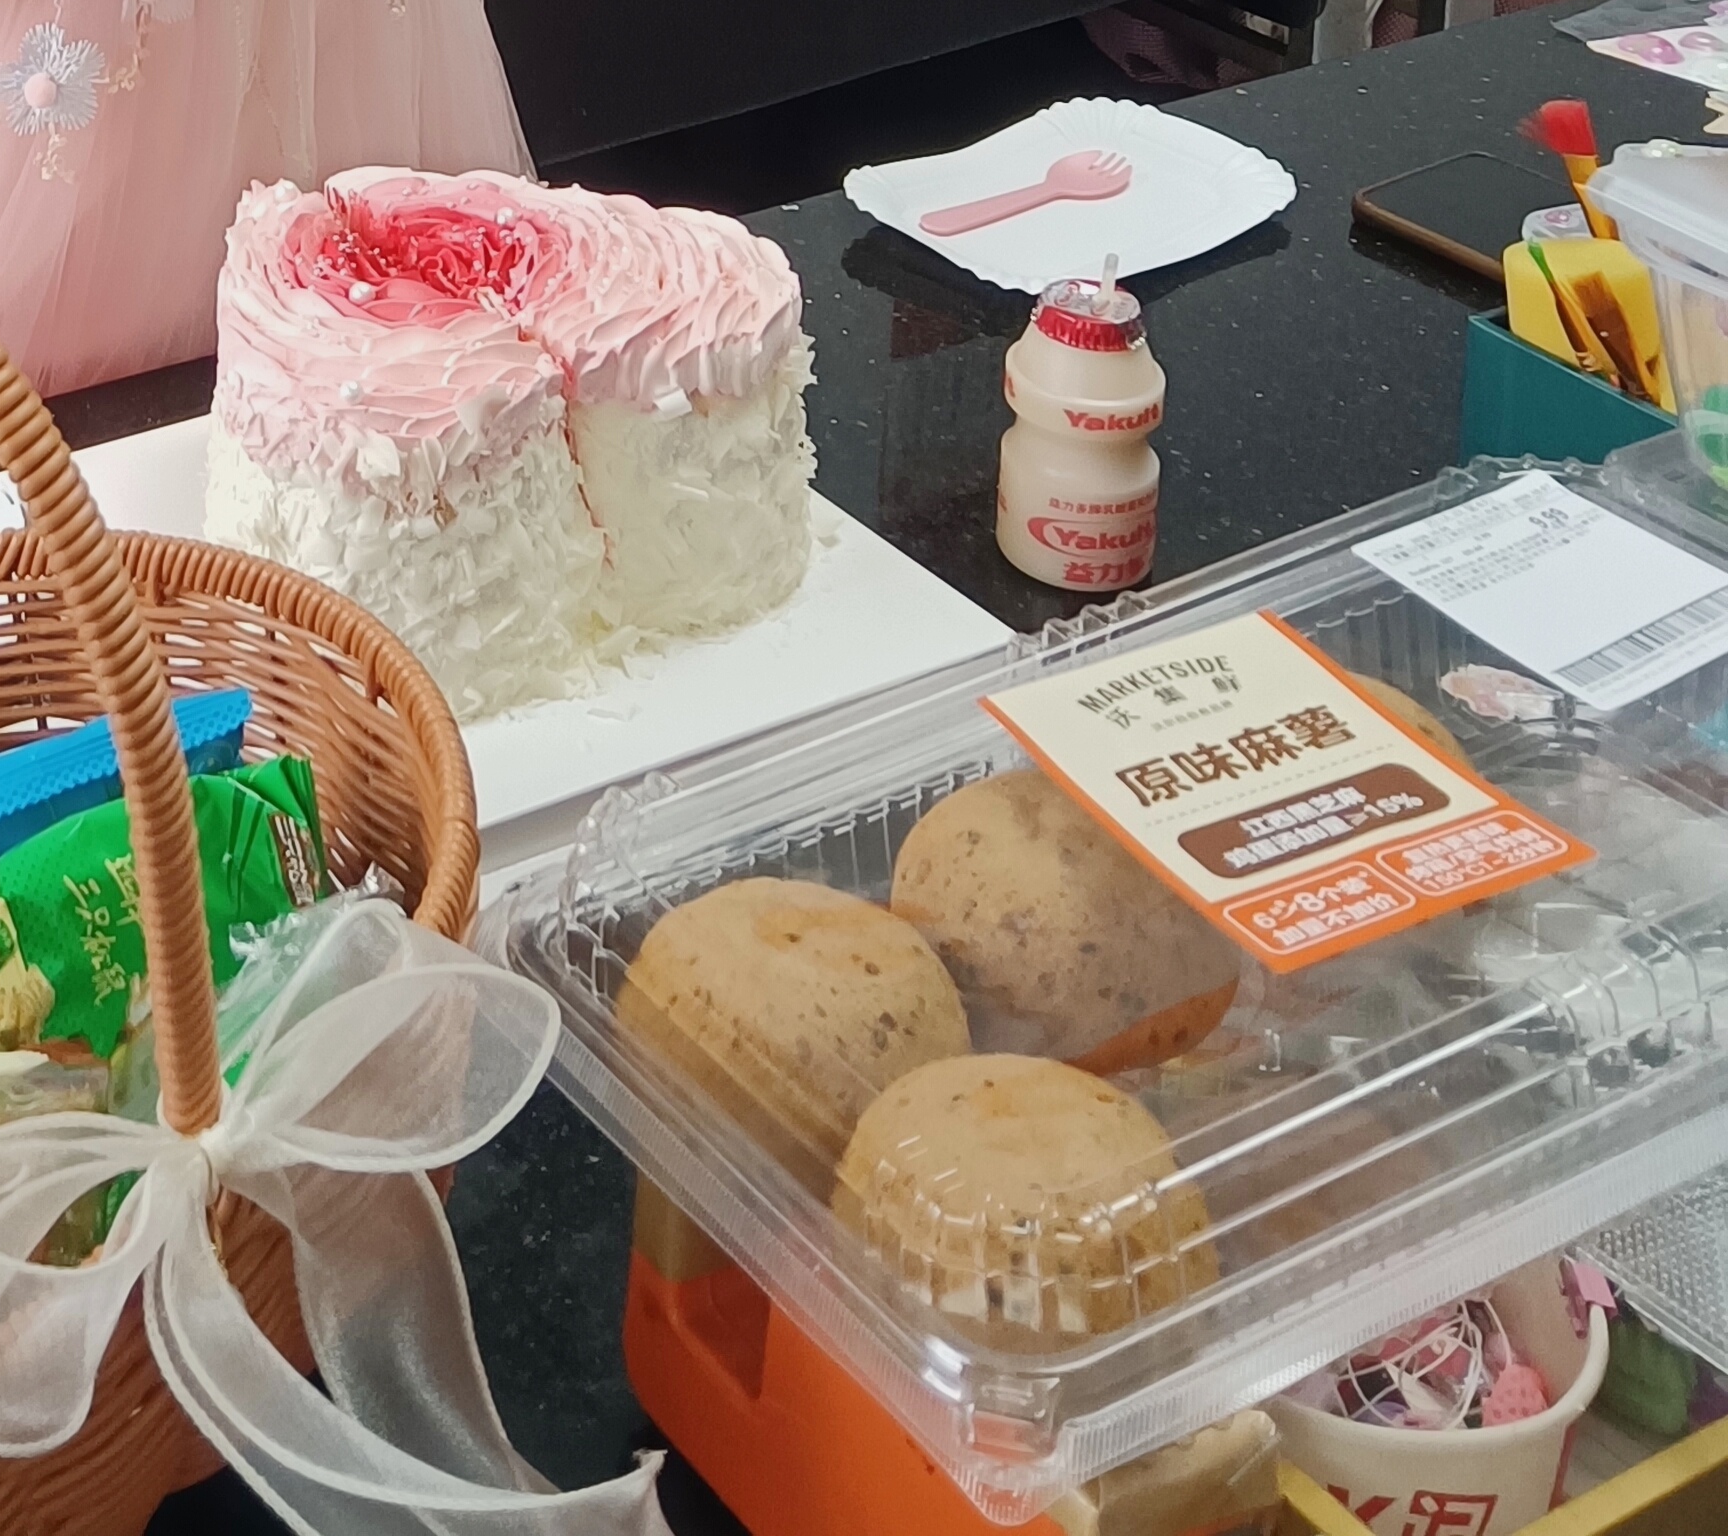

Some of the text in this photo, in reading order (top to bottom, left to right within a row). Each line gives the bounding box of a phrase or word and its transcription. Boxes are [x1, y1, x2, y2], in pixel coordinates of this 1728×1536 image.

[1062, 402, 1160, 431] Yakult
[1076, 654, 1232, 715] MARKETSIDE
[1114, 703, 1357, 808] 原味麻薯
